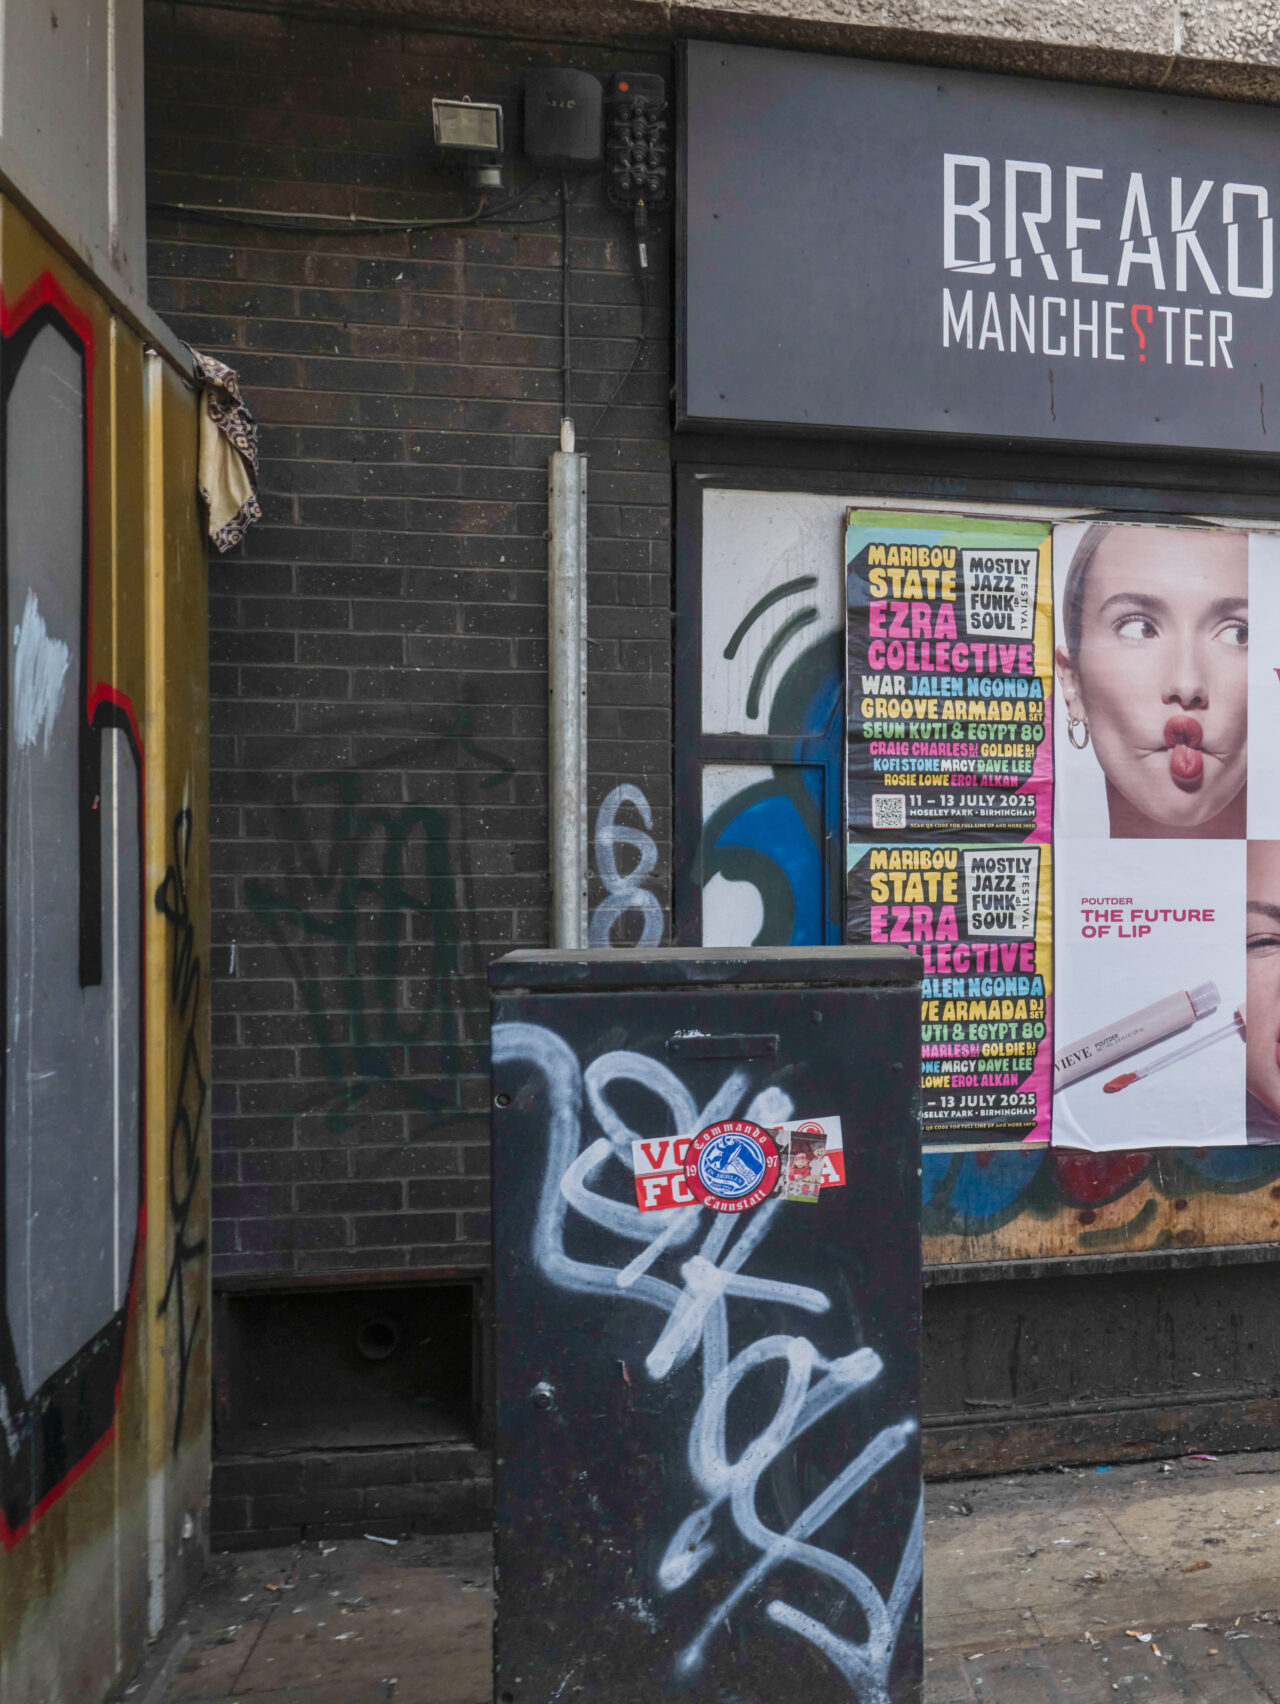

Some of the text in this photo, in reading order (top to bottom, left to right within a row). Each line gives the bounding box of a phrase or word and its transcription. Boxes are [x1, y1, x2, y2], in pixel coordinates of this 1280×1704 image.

[868, 545, 957, 568] MARIBOU
[969, 557, 1031, 575] MOSTLY
[868, 568, 957, 601] STATE
[970, 575, 1015, 592] JAZZ
[971, 594, 1015, 612] FUNK
[1020, 576, 1029, 631] FESTIVAL
[869, 600, 958, 640] EZRA
[971, 612, 1015, 631] SOUL
[867, 639, 1034, 675] COLLECTIVE
[861, 675, 1043, 699] WAR JALEN NGONDA
[861, 698, 1043, 721] GROOVE ARMADA DJ
[1028, 713, 1043, 722] SET
[862, 721, 1044, 742] SEUN KUTI & EGYPT 80
[869, 741, 910, 756] CRAIG
[911, 741, 969, 757] CHARLES
[980, 743, 1024, 758] GOLDIE
[873, 758, 1032, 773] KOFI STONE MRCY DAVE LEE
[883, 773, 1019, 788] ROSIE LOWE EROL ALKAN
[910, 794, 923, 807] 11
[940, 794, 955, 807] 13
[958, 794, 996, 807] JULY
[999, 794, 1036, 807] 2025
[909, 809, 1036, 817] MOSELEY PARK BIRMINGHAM
[869, 849, 959, 870] MARIBOU
[971, 857, 1032, 874] MOSTLY
[870, 871, 959, 903] STATE
[972, 875, 1016, 892] JAZZ
[972, 894, 1016, 911] FUNK
[1021, 875, 1030, 930] FESTIVAL
[1081, 897, 1133, 906] POUTDER
[870, 905, 959, 943] EZRA
[972, 912, 1017, 930] SOUL
[1081, 908, 1215, 923] THE FUTURE
[1081, 925, 1152, 939] OF LIP
[921, 975, 1045, 998] ALEN NGONDA
[942, 999, 1028, 1022] ARMADA
[1029, 999, 1044, 1011] DJ
[1029, 1010, 1045, 1019] SET
[921, 1022, 1046, 1042] UTI & EGYPT 80
[921, 1044, 970, 1059] HARLES
[981, 1042, 1026, 1058] GOLDIE
[941, 1060, 977, 1073] MRCY
[977, 1058, 1010, 1072] DAVE
[1012, 1057, 1033, 1071] LEE
[951, 1074, 983, 1088] EROL
[980, 1073, 1019, 1087] ALKAN
[940, 1096, 955, 1108] 13
[959, 1095, 996, 1108] JULY
[1000, 1093, 1037, 1106] 2025
[950, 1110, 974, 1118] PARK
[980, 1108, 1037, 1117] BIRMINGHAM
[694, 1122, 767, 1150] Commando
[686, 1155, 779, 1177] 19 97
[704, 1189, 767, 1212] Cannstatt
